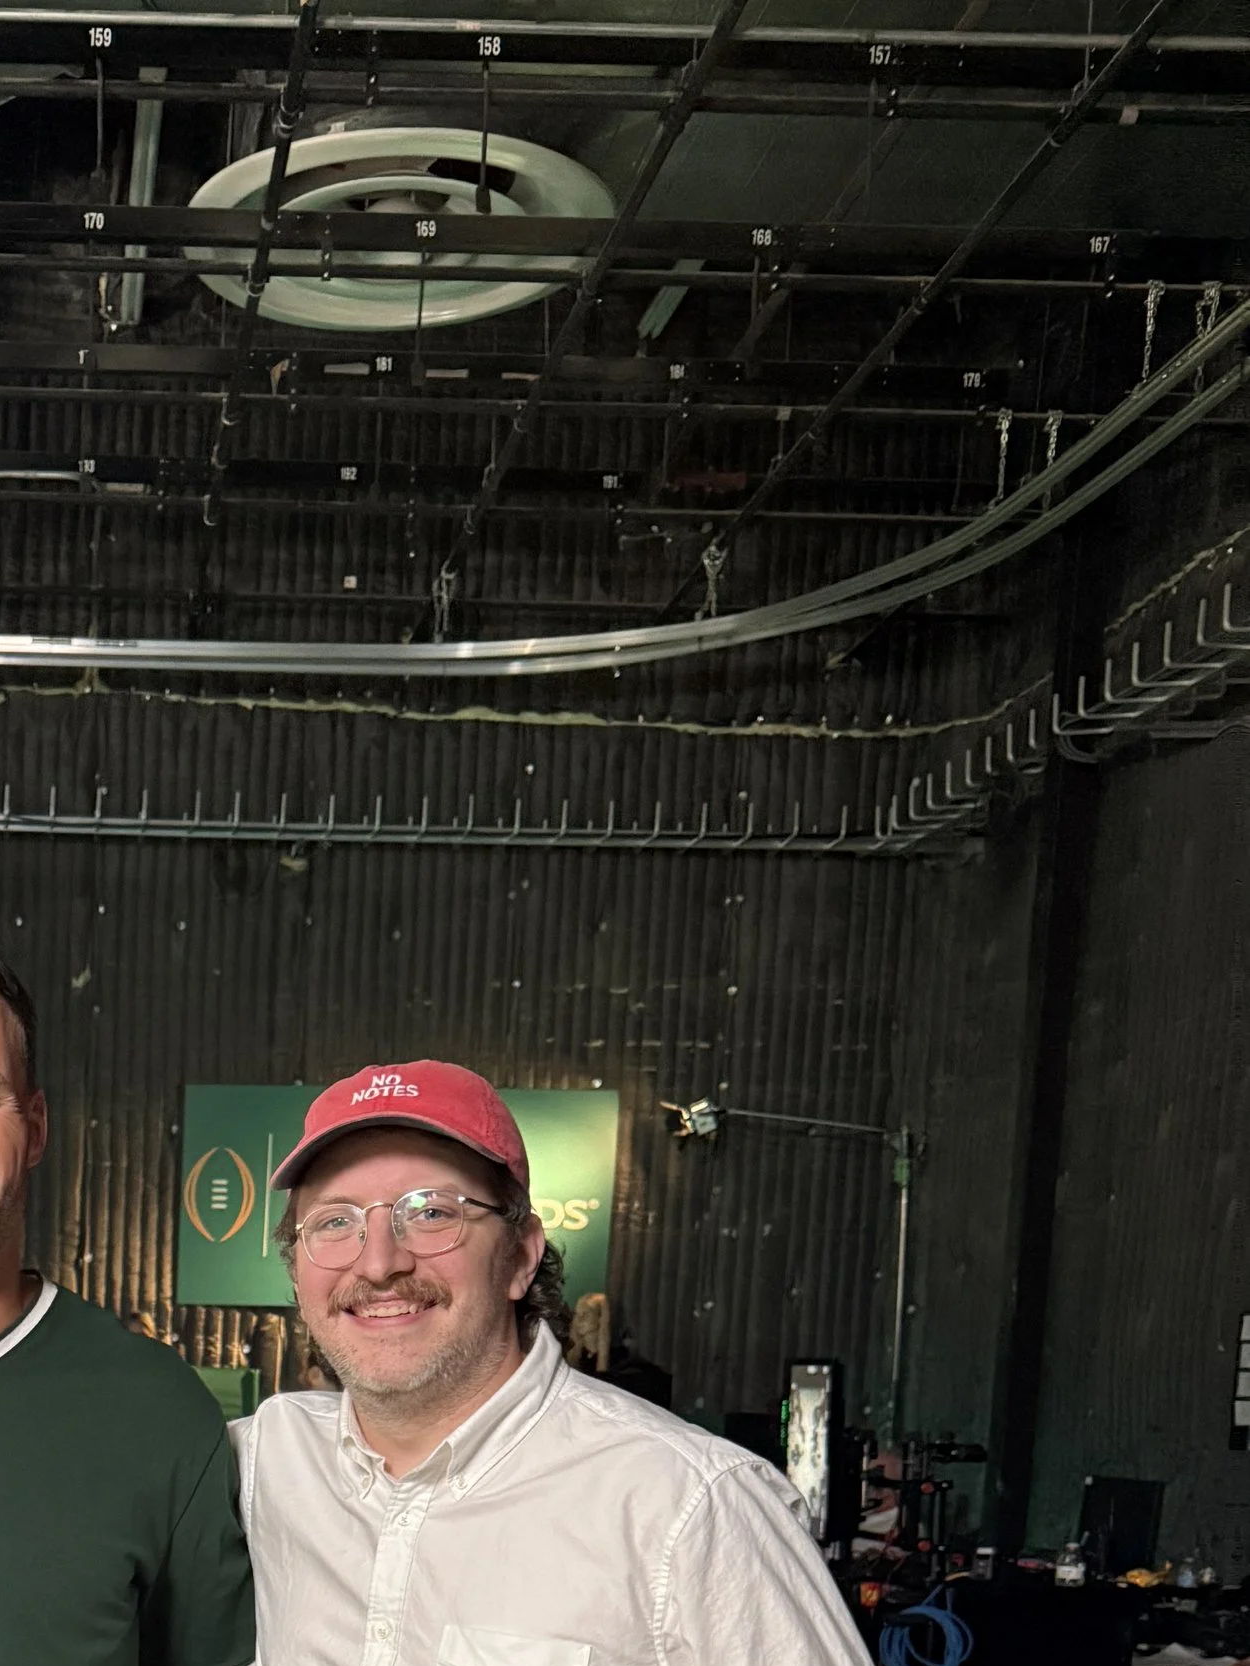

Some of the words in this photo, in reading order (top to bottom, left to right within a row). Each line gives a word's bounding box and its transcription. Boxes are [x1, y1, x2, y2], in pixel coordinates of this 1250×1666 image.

[88, 27, 112, 47] 159
[477, 36, 501, 56] 158
[869, 45, 891, 65] 157
[83, 212, 105, 230] 170
[415, 220, 437, 237] 169
[751, 228, 772, 246] 168
[1089, 236, 1110, 253] 167
[371, 1074, 402, 1087] NO
[350, 1084, 419, 1105] NOTES
